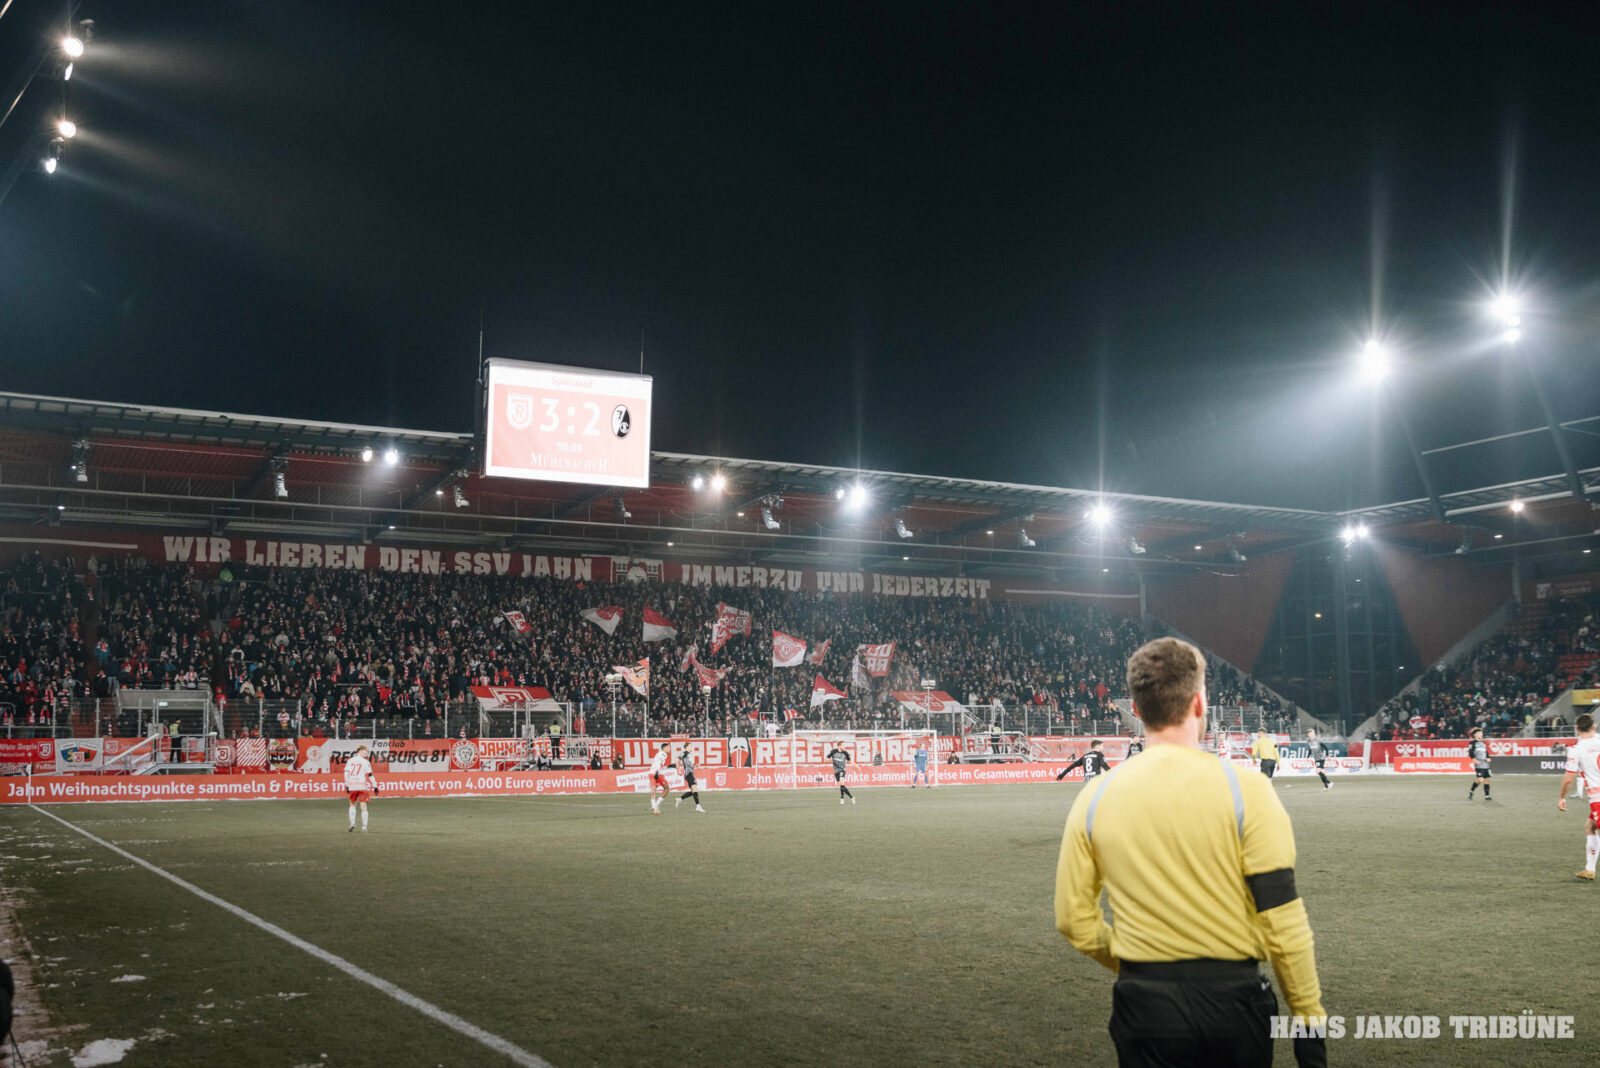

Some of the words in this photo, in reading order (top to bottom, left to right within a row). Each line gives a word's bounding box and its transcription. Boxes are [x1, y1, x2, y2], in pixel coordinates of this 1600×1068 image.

[163, 536, 231, 562] WIR
[245, 540, 366, 569] LIEBEN
[379, 547, 440, 575] DEN
[454, 552, 511, 575] SSV
[520, 555, 592, 581] JAHN
[681, 564, 801, 591] IMMERZU
[816, 571, 864, 593] UND
[872, 573, 990, 599] JEDERZEIT
[372, 740, 405, 748] Fanclub
[1416, 744, 1470, 757] humme
[331, 750, 428, 765] RENSBURG
[430, 750, 447, 763] 81
[624, 741, 722, 766] ULRAS
[1085, 757, 1093, 773] 8
[1541, 761, 1555, 769] DU
[747, 773, 771, 784] Jahn
[928, 769, 957, 780] Peise
[960, 769, 972, 779] im
[974, 767, 1028, 779] Gesamtwert
[1031, 767, 1046, 777] von
[8, 783, 46, 797] Jahn
[50, 782, 194, 798] Weihnachtspunkte
[199, 780, 265, 795] sammeln
[269, 780, 281, 792] &
[284, 779, 328, 793] Preise
[332, 779, 346, 792] im
[440, 779, 462, 789] von
[465, 777, 502, 790] 4.000
[506, 776, 533, 789] Euro
[536, 776, 596, 791] gewinnen
